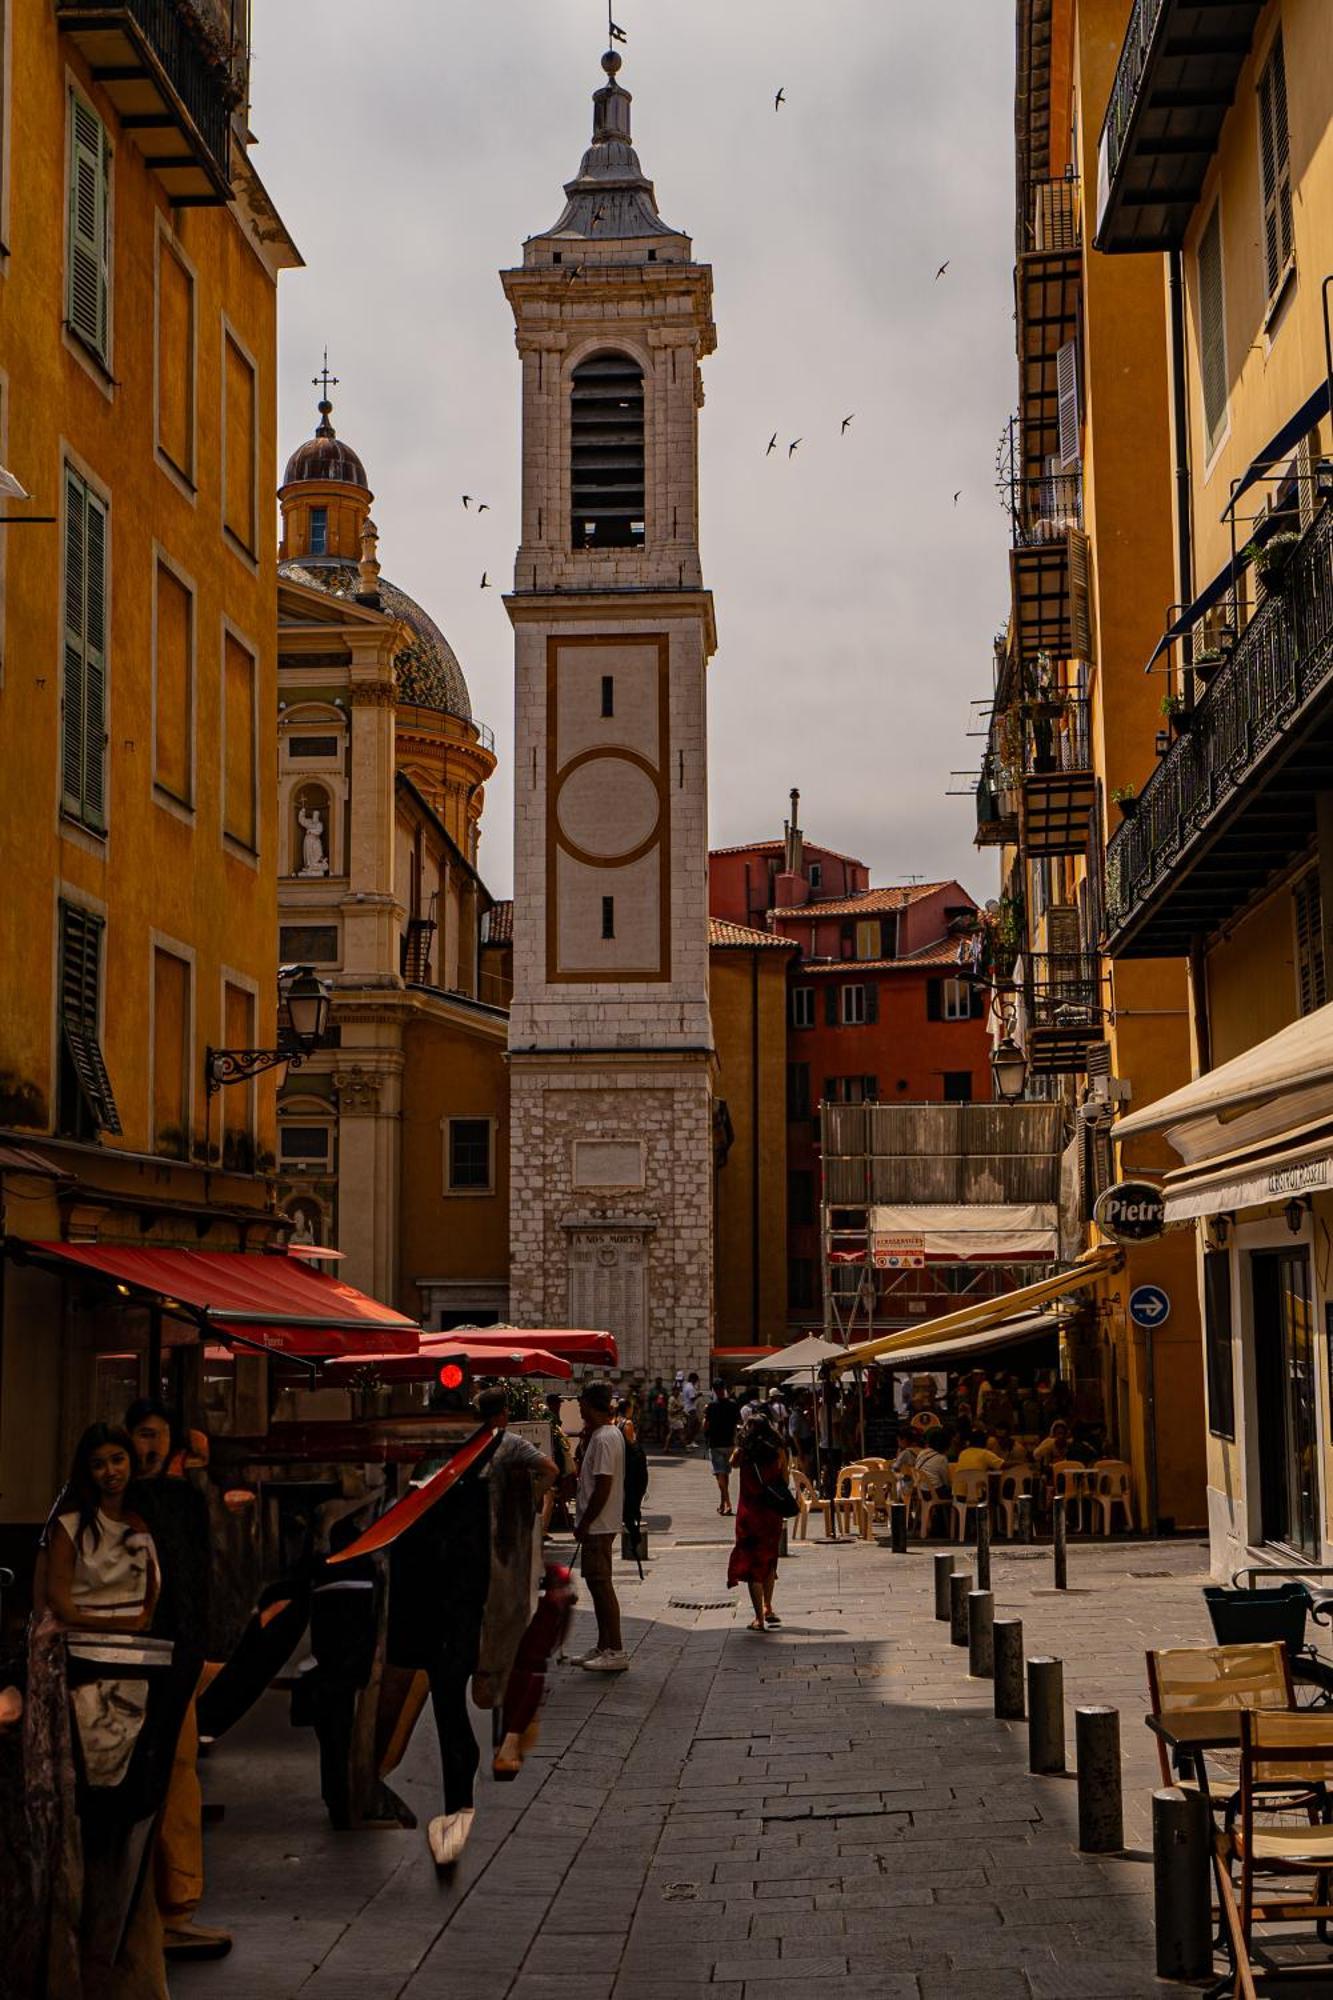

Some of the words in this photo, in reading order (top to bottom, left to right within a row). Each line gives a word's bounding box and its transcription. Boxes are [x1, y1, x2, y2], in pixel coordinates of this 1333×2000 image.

[1105, 1200, 1164, 1222] Pietra
[586, 1235, 605, 1243] NOS
[610, 1234, 641, 1243] MORTS
